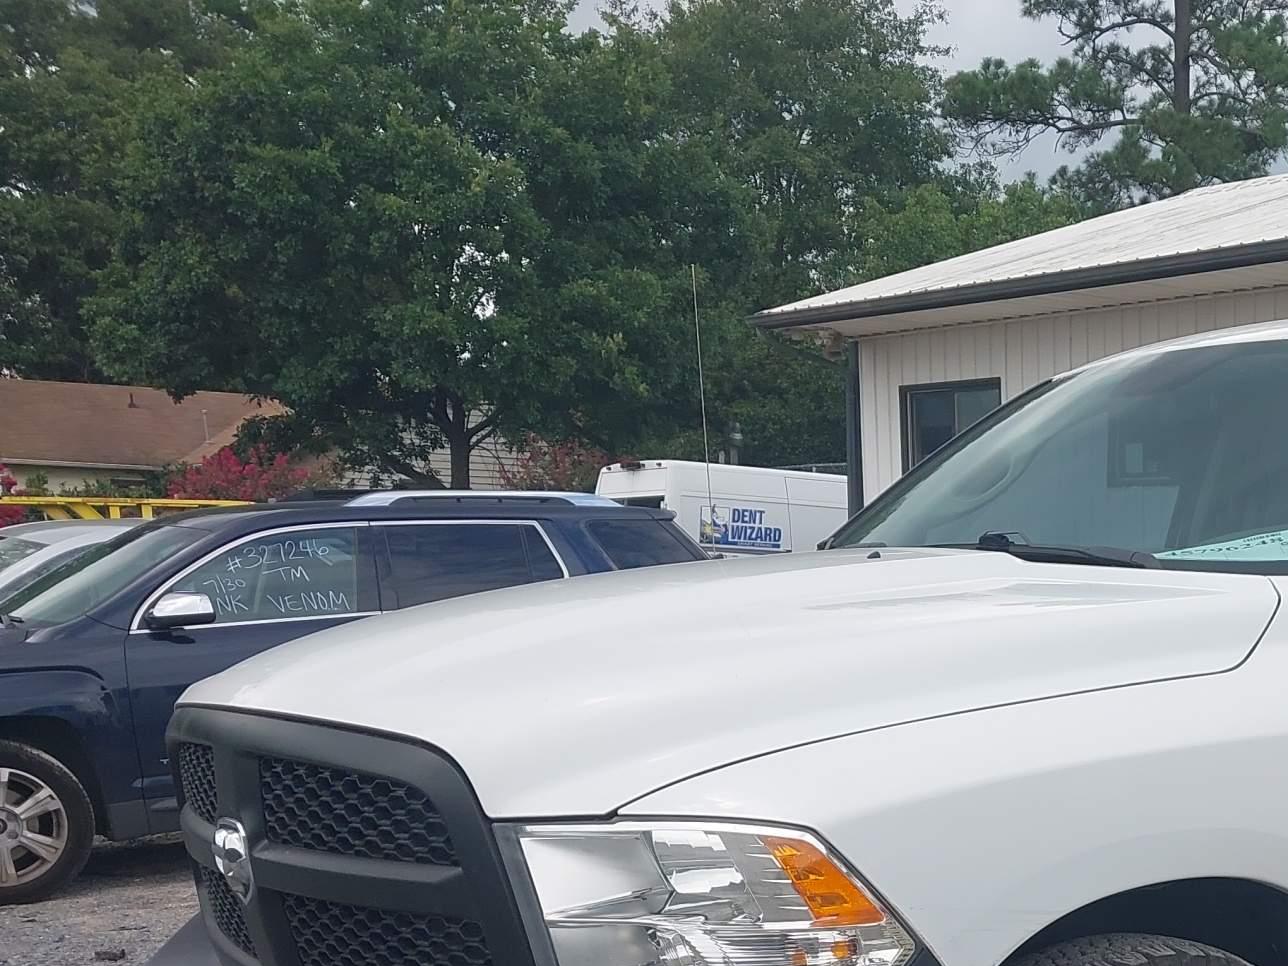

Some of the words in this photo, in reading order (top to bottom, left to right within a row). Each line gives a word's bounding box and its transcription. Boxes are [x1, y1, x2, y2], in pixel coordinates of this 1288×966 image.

[732, 508, 765, 525] DENT
[731, 525, 782, 542] WIZARD
[226, 540, 329, 573] #327246
[261, 566, 310, 583] TM
[203, 575, 246, 595] 7/30
[216, 594, 249, 616] NK
[267, 590, 351, 613] VENOM
